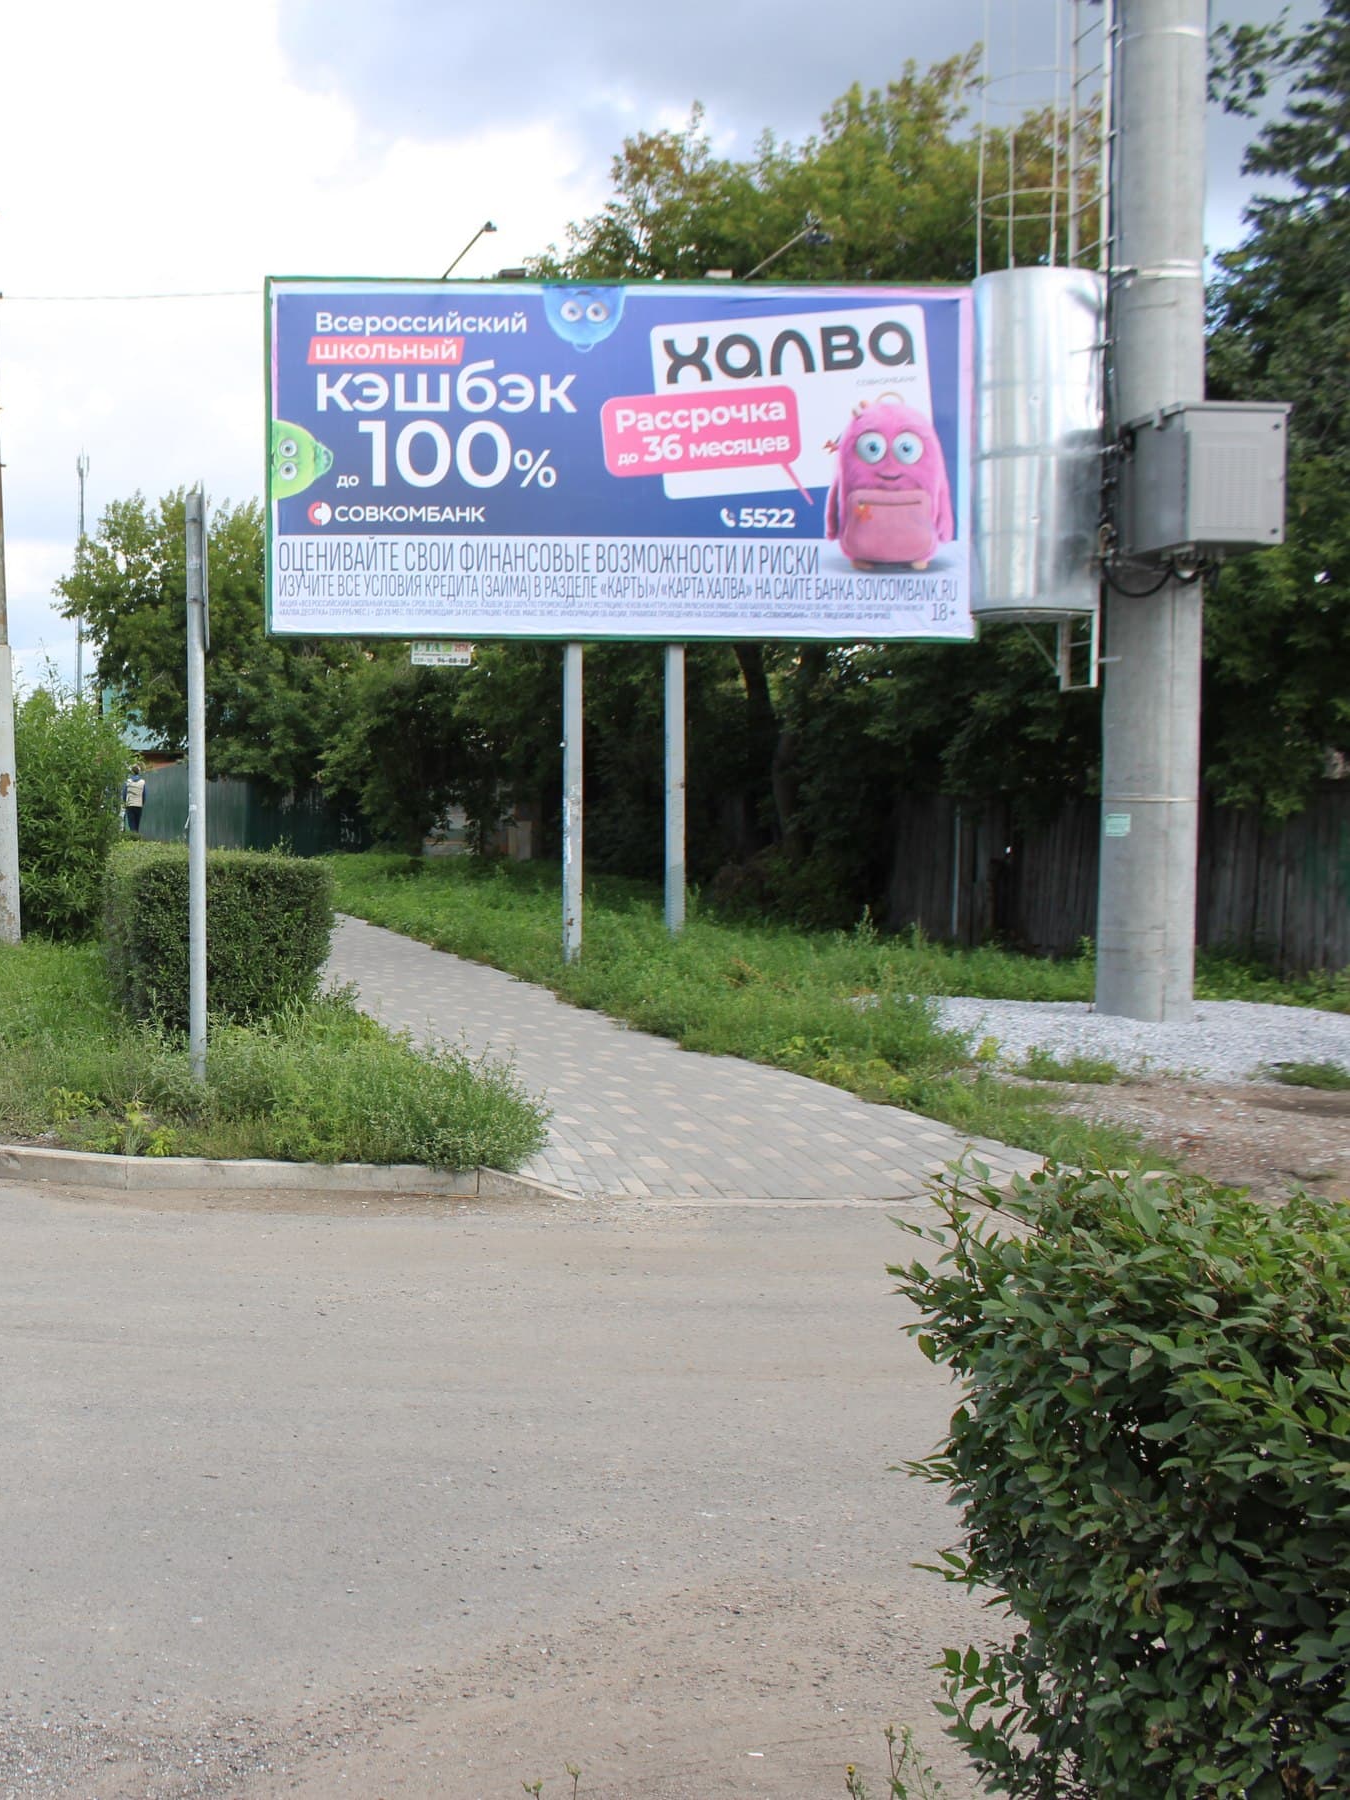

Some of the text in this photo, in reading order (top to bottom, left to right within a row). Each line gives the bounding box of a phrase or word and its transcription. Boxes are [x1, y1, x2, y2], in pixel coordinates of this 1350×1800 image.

[315, 311, 527, 336] Всероссийский
[315, 339, 458, 361] школьный
[316, 359, 578, 414] кэшбэк
[615, 400, 788, 436] Рассрочка
[336, 419, 558, 489] до 100%
[617, 433, 791, 467] до 36 месяцев
[334, 505, 486, 523] СОВКОМБАНК
[738, 507, 797, 530] 5522
[278, 536, 819, 576] ОЦЕНИВАЙТЕ СВОИ ФИНАНСОВЫЕ ВОЗМОЖНОСТИ И РИСКИ
[278, 574, 334, 598] ИЗУЧИТЕ
[337, 574, 361, 598] ВСЕ
[364, 574, 422, 598] УСЛОВИЯ
[424, 575, 479, 600] КРЕДИТА
[534, 576, 542, 598] В
[544, 576, 597, 601] РАЗДЕЛЕ
[755, 577, 771, 600] НА
[815, 577, 853, 600] БАНКА
[931, 602, 958, 622] 18+
